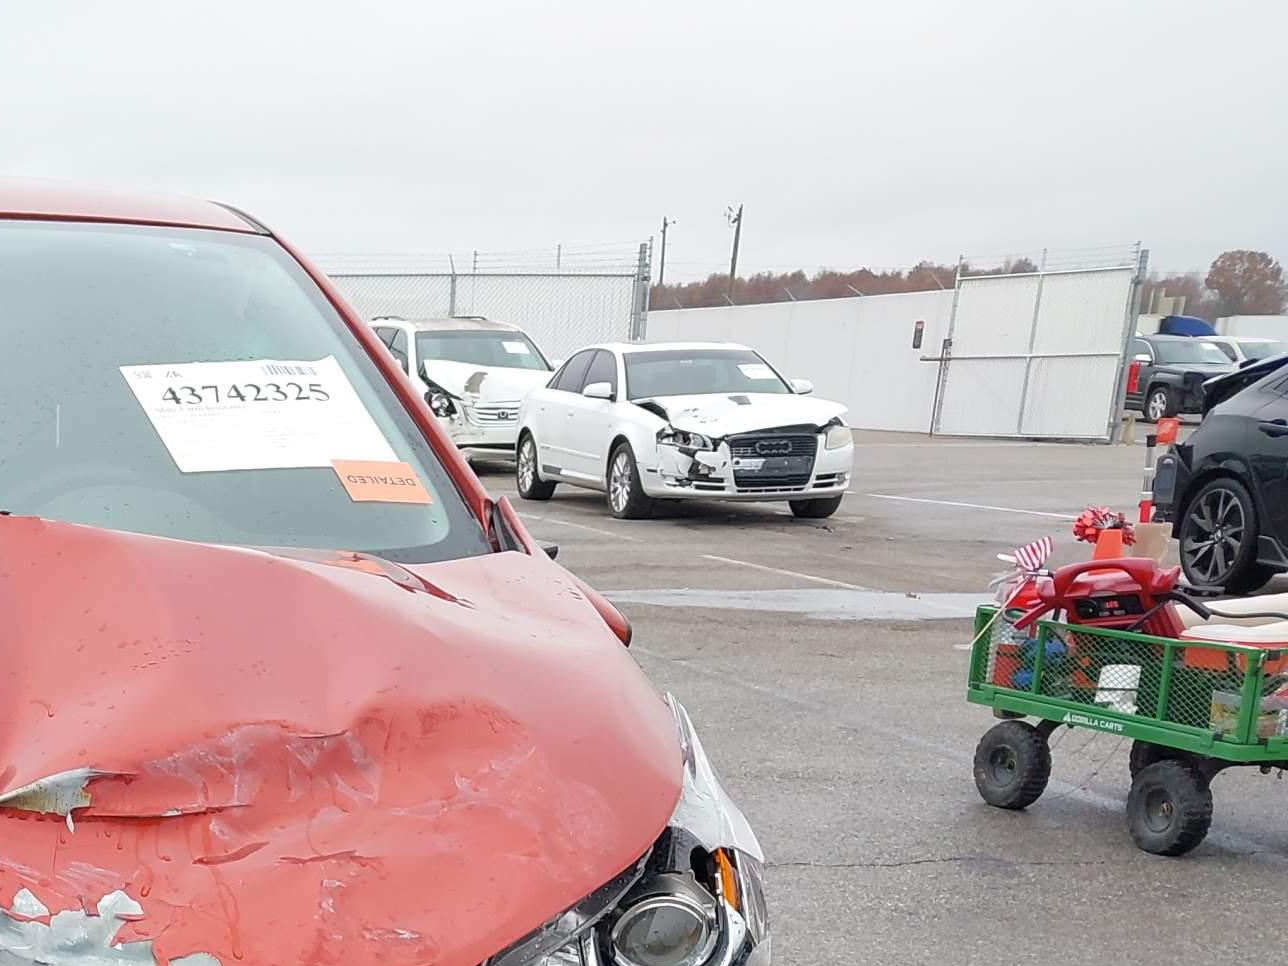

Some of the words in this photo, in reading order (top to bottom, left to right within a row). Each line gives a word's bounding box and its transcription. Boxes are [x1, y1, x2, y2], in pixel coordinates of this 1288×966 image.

[162, 382, 330, 405] 43742325
[347, 474, 416, 487] DETAILED
[1100, 720, 1123, 731] CARTS
